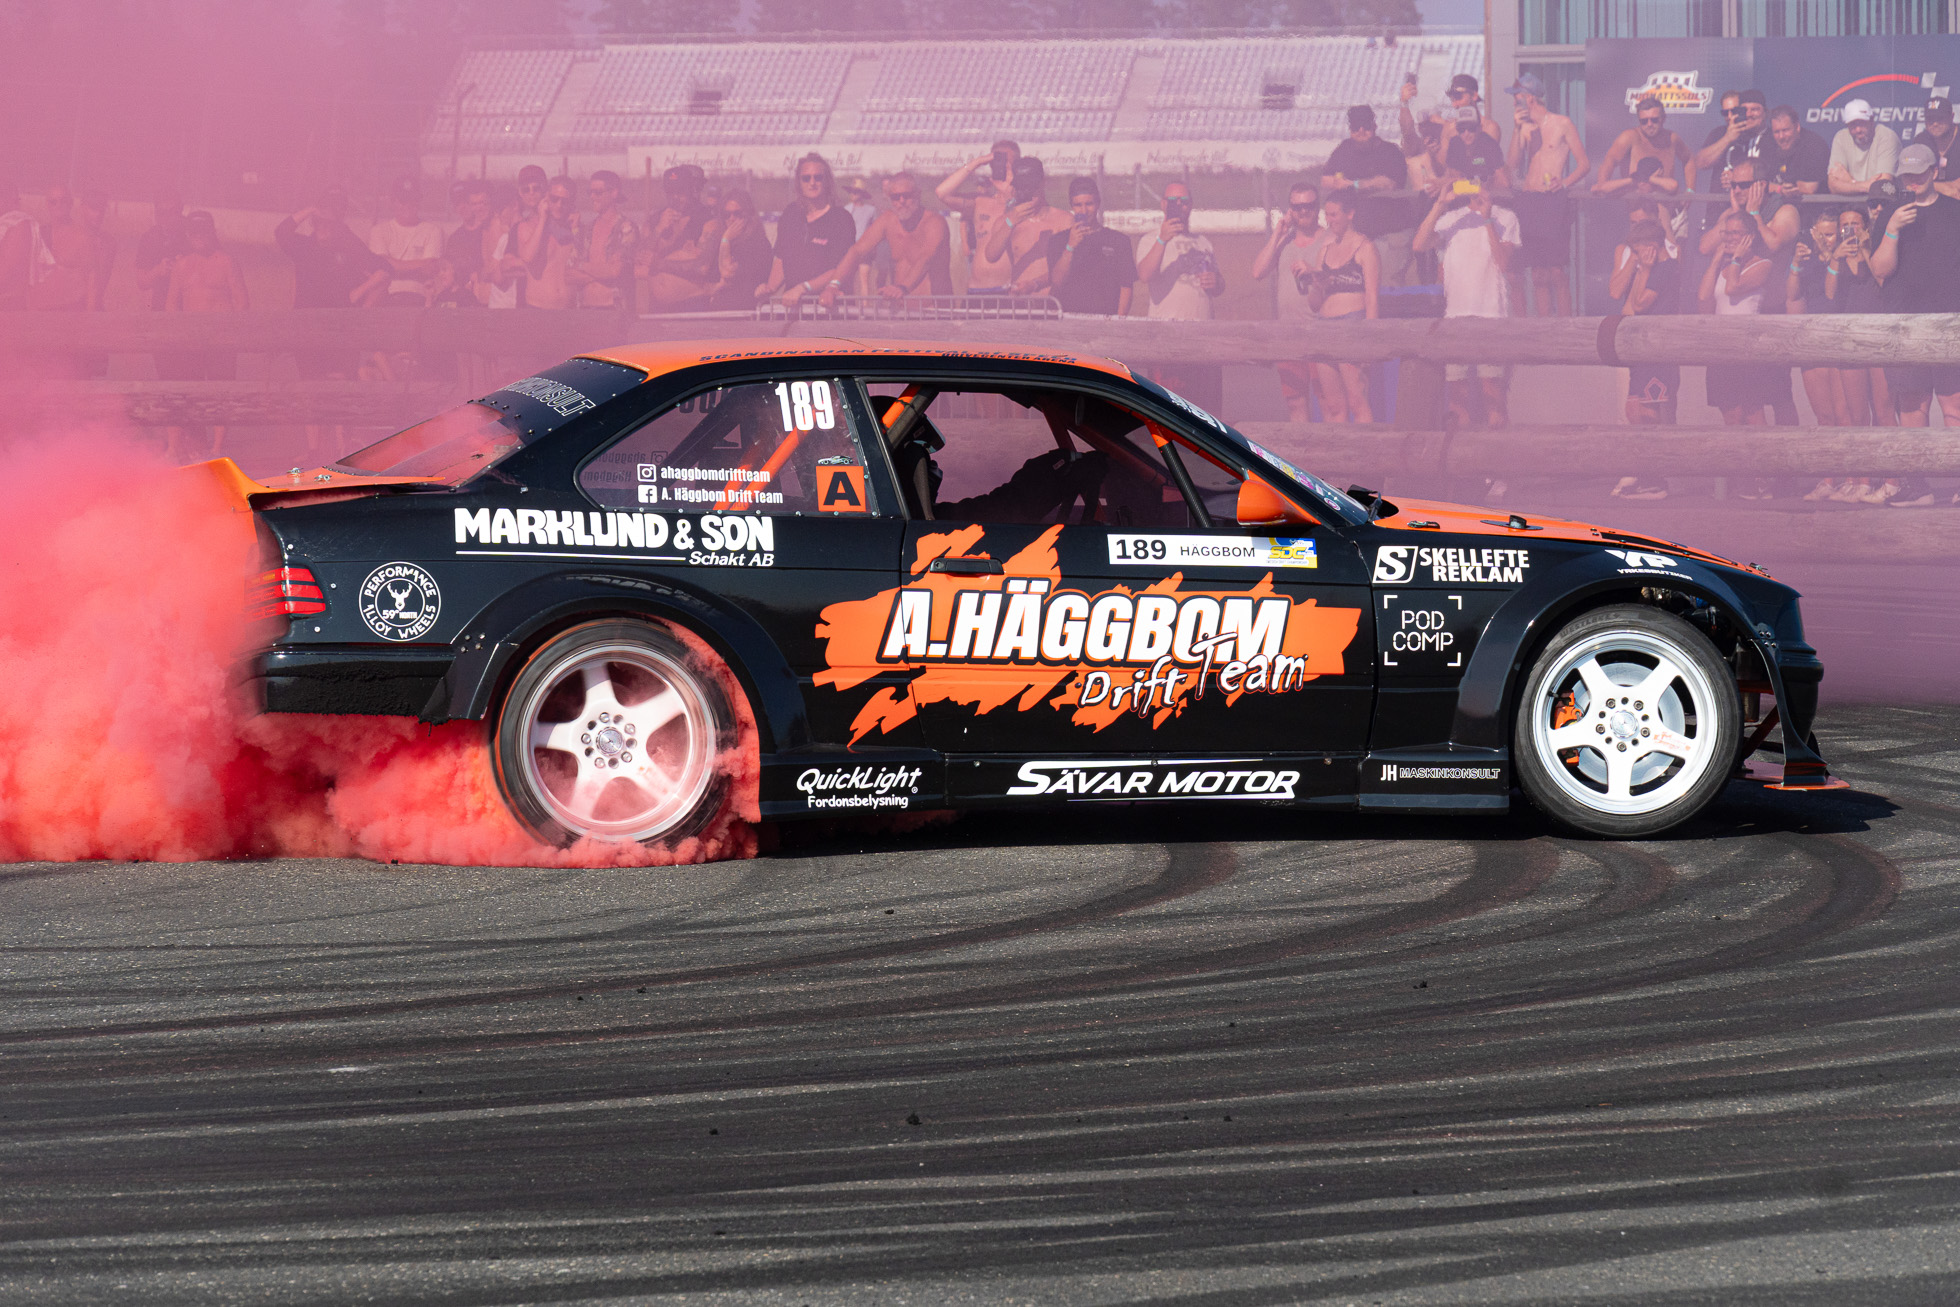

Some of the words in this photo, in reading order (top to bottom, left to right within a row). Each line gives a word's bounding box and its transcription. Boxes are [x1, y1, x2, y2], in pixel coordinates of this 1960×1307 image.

[775, 380, 836, 432] 189
[660, 466, 772, 483] ahaggbomdriftteam
[661, 487, 672, 501] A.
[674, 487, 727, 503] Häggbom
[727, 489, 752, 504] Drift
[754, 490, 784, 504] Team
[823, 471, 861, 506] A
[454, 508, 669, 548] MARKLUND
[673, 519, 695, 550] &
[700, 514, 775, 551] SON
[689, 551, 746, 566] Schakt
[747, 553, 775, 567] AB
[1115, 539, 1167, 560] 189
[1180, 543, 1256, 558] HÄGGBOM
[1267, 546, 1308, 560] SDC
[1420, 547, 1530, 568] SKELLEFTE
[1433, 566, 1524, 583] REKLAM
[398, 605, 436, 639] WHEELS
[881, 579, 1290, 662] A.HÄGGBOM
[1401, 610, 1445, 630] POD
[1392, 631, 1454, 652] COMP
[1080, 654, 1189, 715] Drift
[1190, 631, 1306, 698] Team
[796, 765, 923, 795] QuickLight
[1006, 759, 1154, 796] SÄVAR
[1158, 770, 1301, 799] MOTOR
[1380, 764, 1398, 782] JH
[1399, 767, 1501, 780] MASKINKONSULT
[808, 794, 909, 810] Fordonsbelysning
